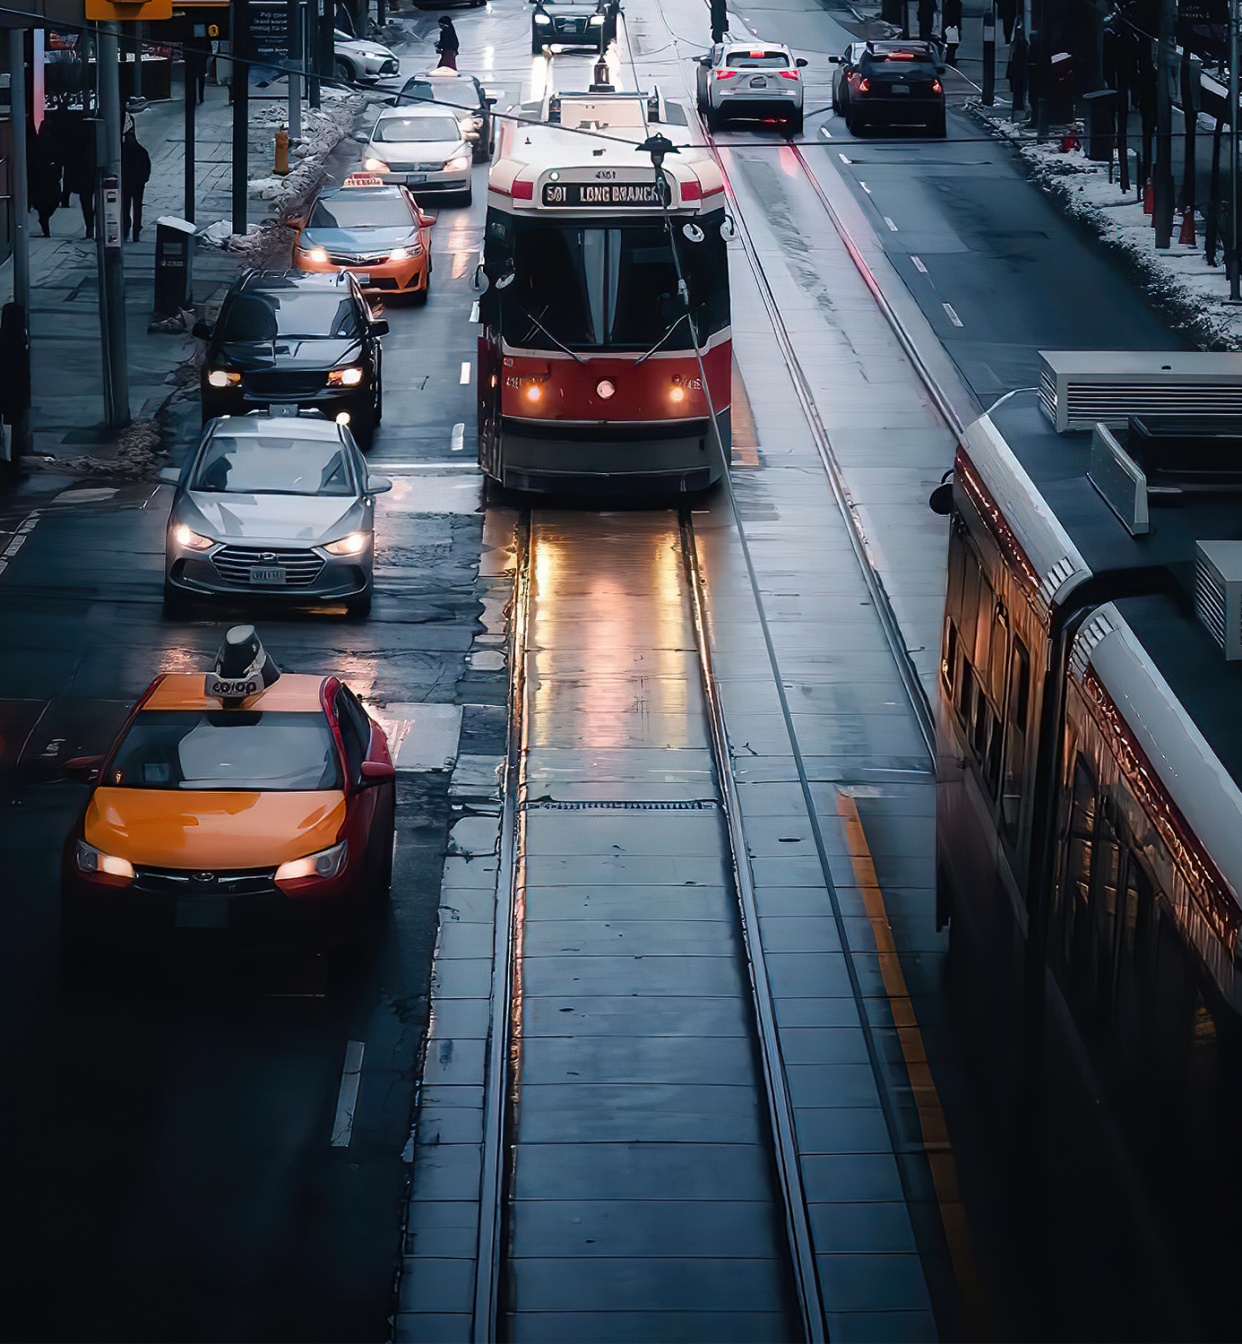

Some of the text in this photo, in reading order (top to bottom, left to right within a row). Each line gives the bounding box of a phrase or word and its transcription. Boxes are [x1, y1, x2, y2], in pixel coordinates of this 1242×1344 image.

[546, 186, 659, 202] 501 LONG BRANCH
